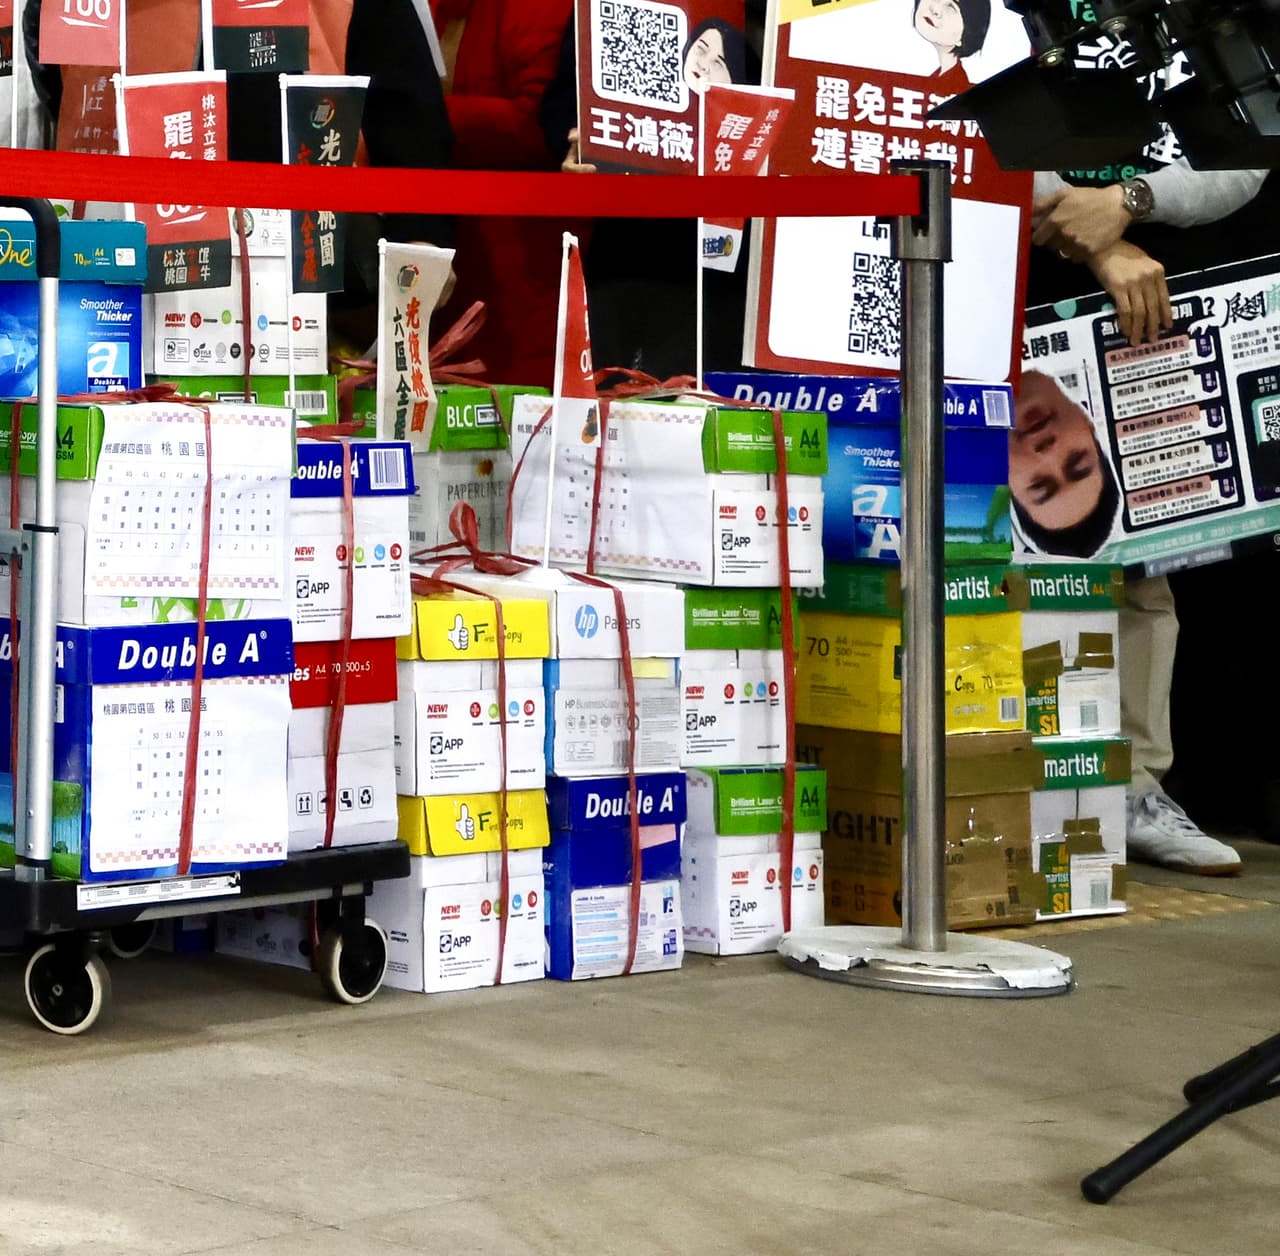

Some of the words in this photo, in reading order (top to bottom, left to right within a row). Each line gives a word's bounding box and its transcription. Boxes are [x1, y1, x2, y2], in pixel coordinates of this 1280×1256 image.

[201, 94, 217, 162] 桃汰立委
[589, 106, 695, 165] 王鴻薇
[714, 112, 753, 174] 罷免
[79, 298, 125, 311] Smoother
[95, 310, 133, 322] Thicker
[404, 295, 429, 434] 光復桃園
[731, 384, 844, 412] Double
[856, 384, 879, 413] A
[968, 399, 978, 415] A
[446, 404, 474, 428] BLC
[799, 428, 821, 449] A4
[843, 445, 896, 458] Smoother
[291, 460, 342, 480] ouble
[862, 456, 902, 468] Thicke
[446, 481, 505, 501] PAPERLINE
[294, 546, 315, 556] NEW!
[733, 536, 751, 548] APP
[310, 582, 330, 594] APP
[944, 575, 990, 601] artist
[1029, 573, 1090, 597] martist
[578, 604, 596, 639] hp
[117, 638, 227, 671] Double
[239, 633, 260, 663] A
[805, 636, 831, 657] 70
[315, 663, 326, 674] A4
[427, 703, 448, 714] NEW!
[698, 715, 717, 727] APP
[444, 738, 464, 751] APP
[1043, 752, 1100, 778] martist
[585, 790, 653, 819] Double
[659, 787, 674, 813] A
[799, 786, 820, 809] A4
[440, 904, 461, 915] NEW!
[741, 900, 758, 914] APP
[453, 935, 471, 948] APP
